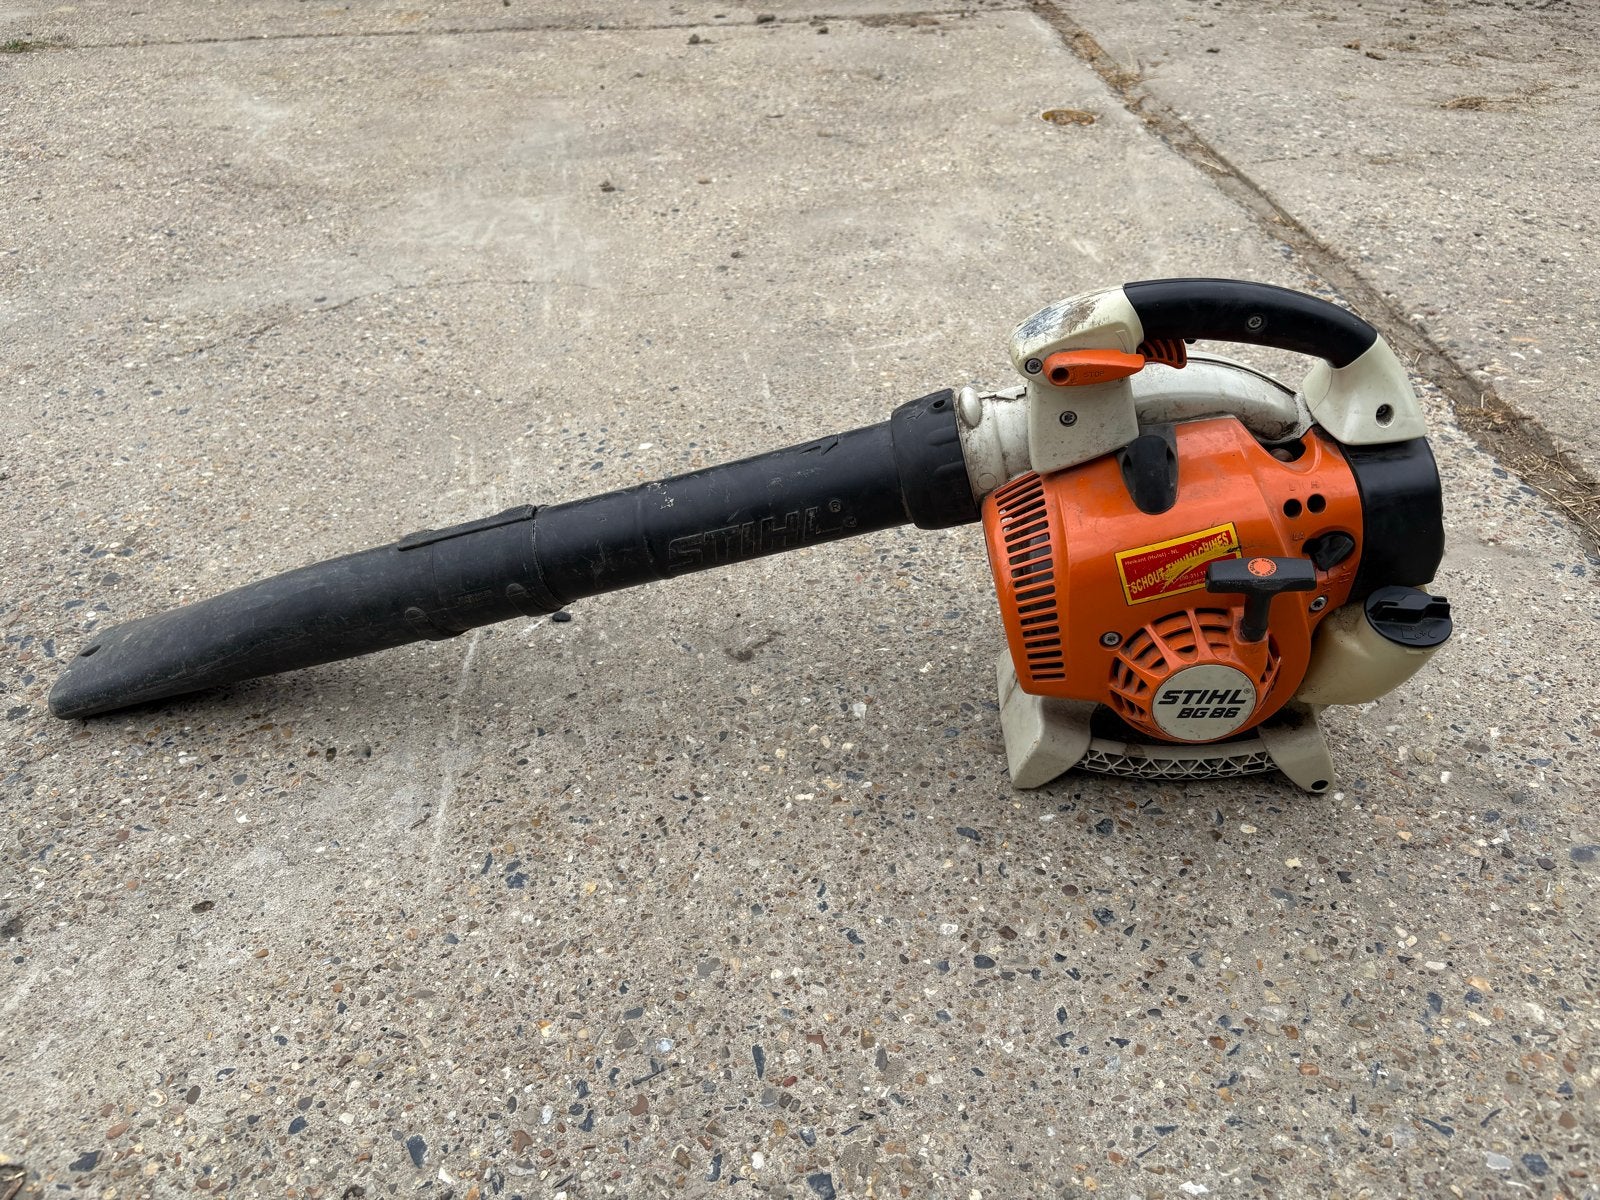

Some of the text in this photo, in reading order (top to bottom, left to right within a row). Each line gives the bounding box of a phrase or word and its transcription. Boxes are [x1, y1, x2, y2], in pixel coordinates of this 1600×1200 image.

[1083, 369, 1105, 378] STOP
[668, 505, 843, 572] STIHL
[1157, 689, 1247, 705] STIHL
[1176, 707, 1241, 719] BG 86
